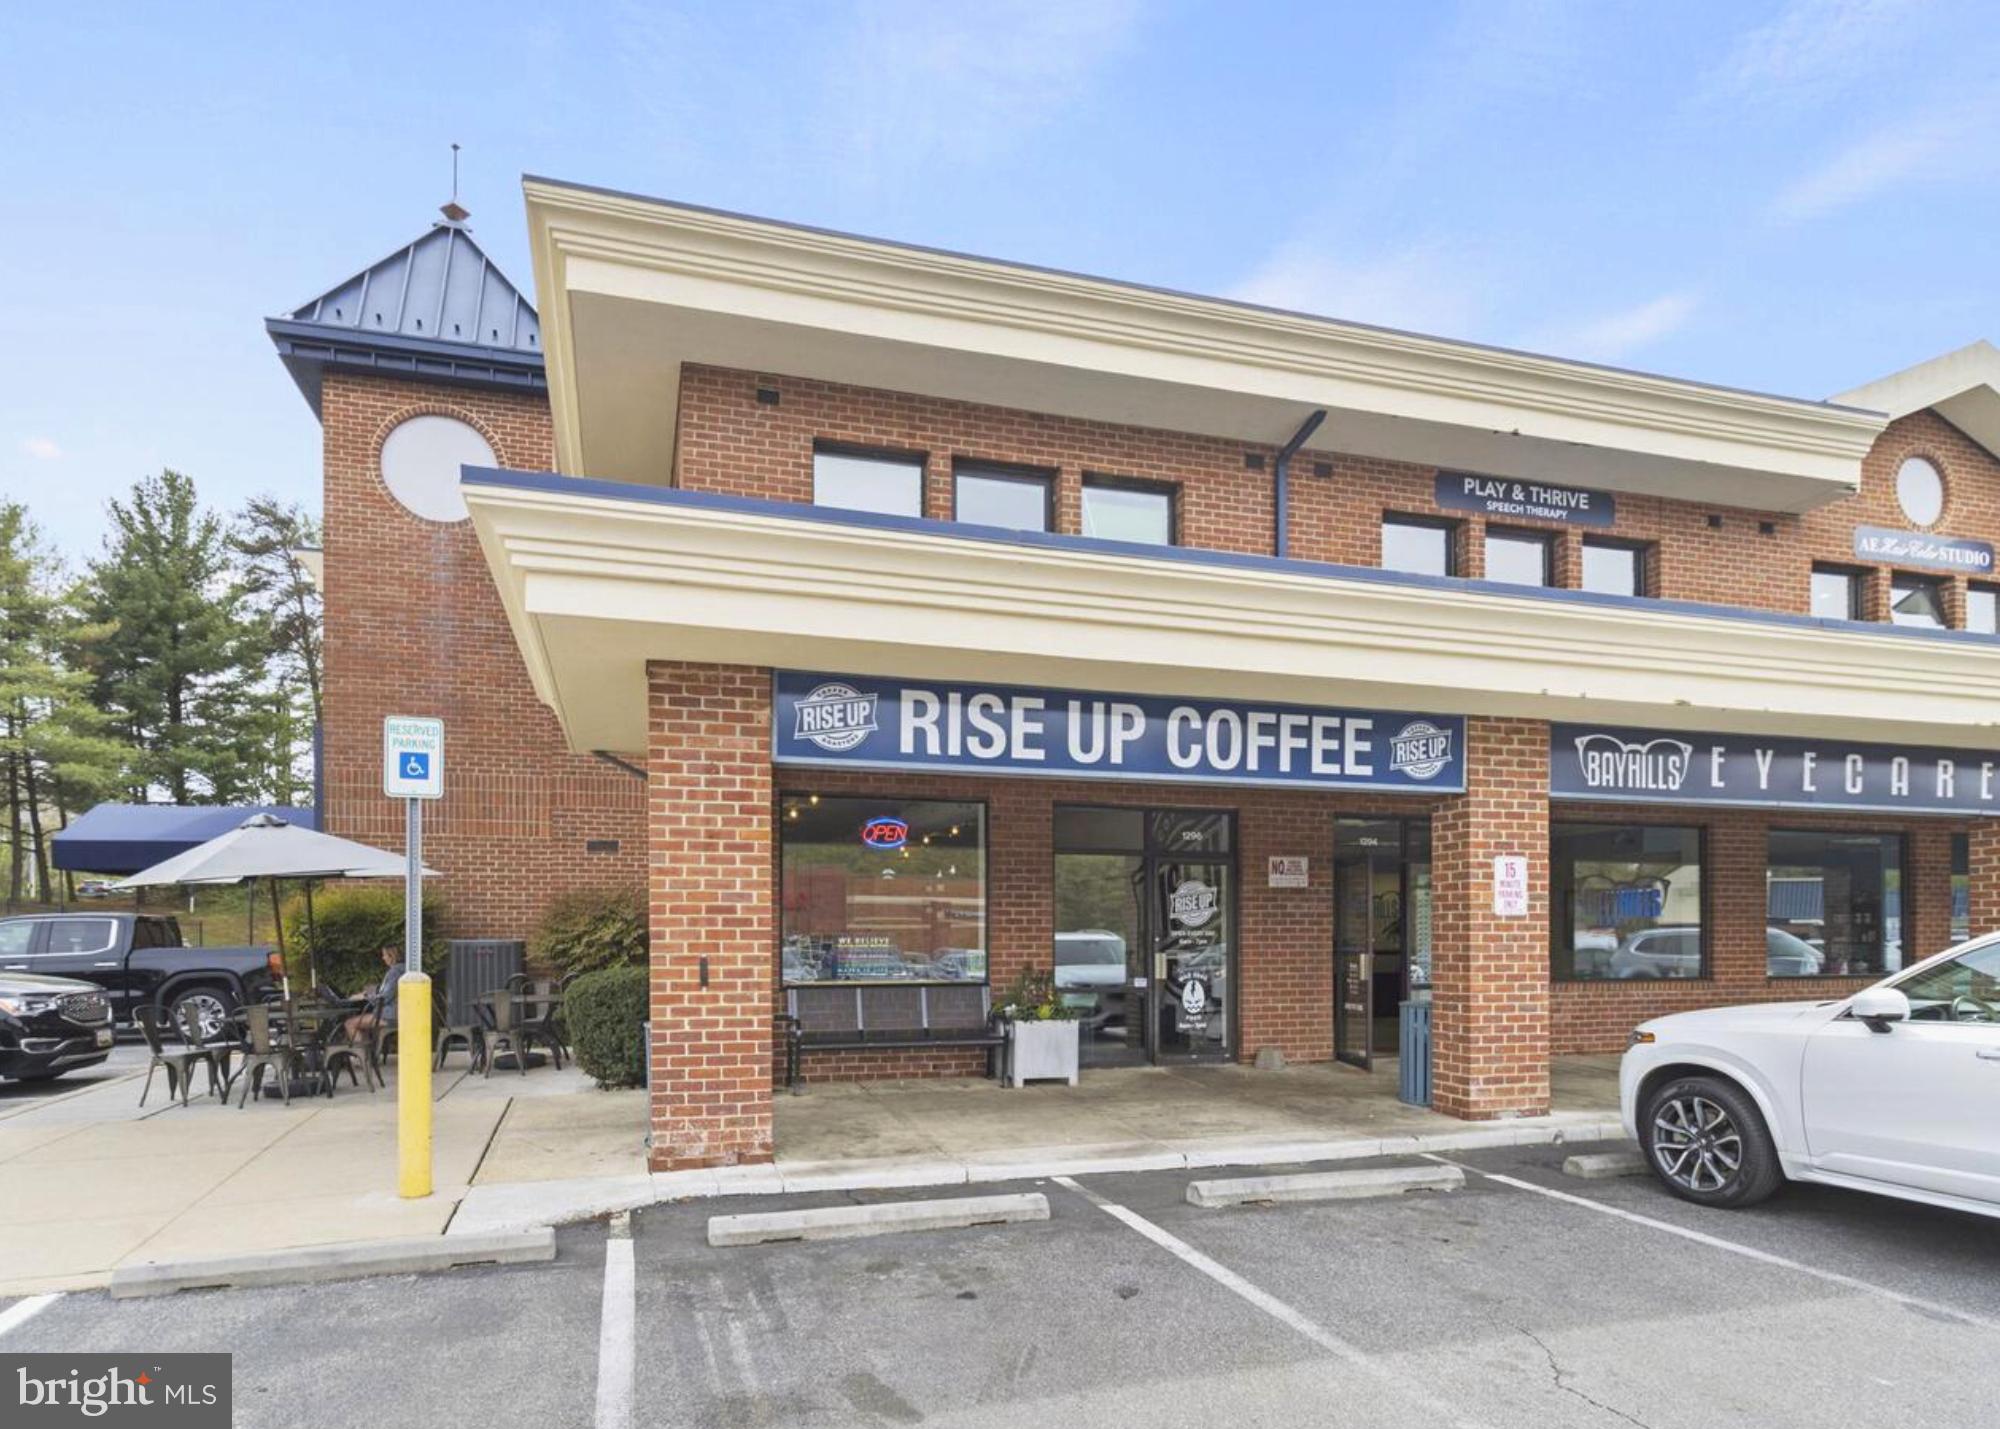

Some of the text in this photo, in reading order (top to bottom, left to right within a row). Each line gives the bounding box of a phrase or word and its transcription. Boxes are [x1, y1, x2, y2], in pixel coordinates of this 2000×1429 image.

[1464, 477, 1590, 510] PLAY & THRIVE
[1486, 500, 1568, 520] SPEECH THERAPY
[1939, 547, 1990, 567] STUDIO
[803, 701, 870, 731] RISE UP
[389, 724, 439, 737] RESERVED
[901, 689, 1373, 776] RISE UP COFFEE
[392, 737, 436, 750] PARKING
[1396, 737, 1447, 763] RISE UP
[1588, 751, 1680, 791] BAYHILLS
[863, 825, 908, 841] OPEN
[1505, 862, 1516, 878] 15
[1175, 893, 1212, 913] RISE UP
